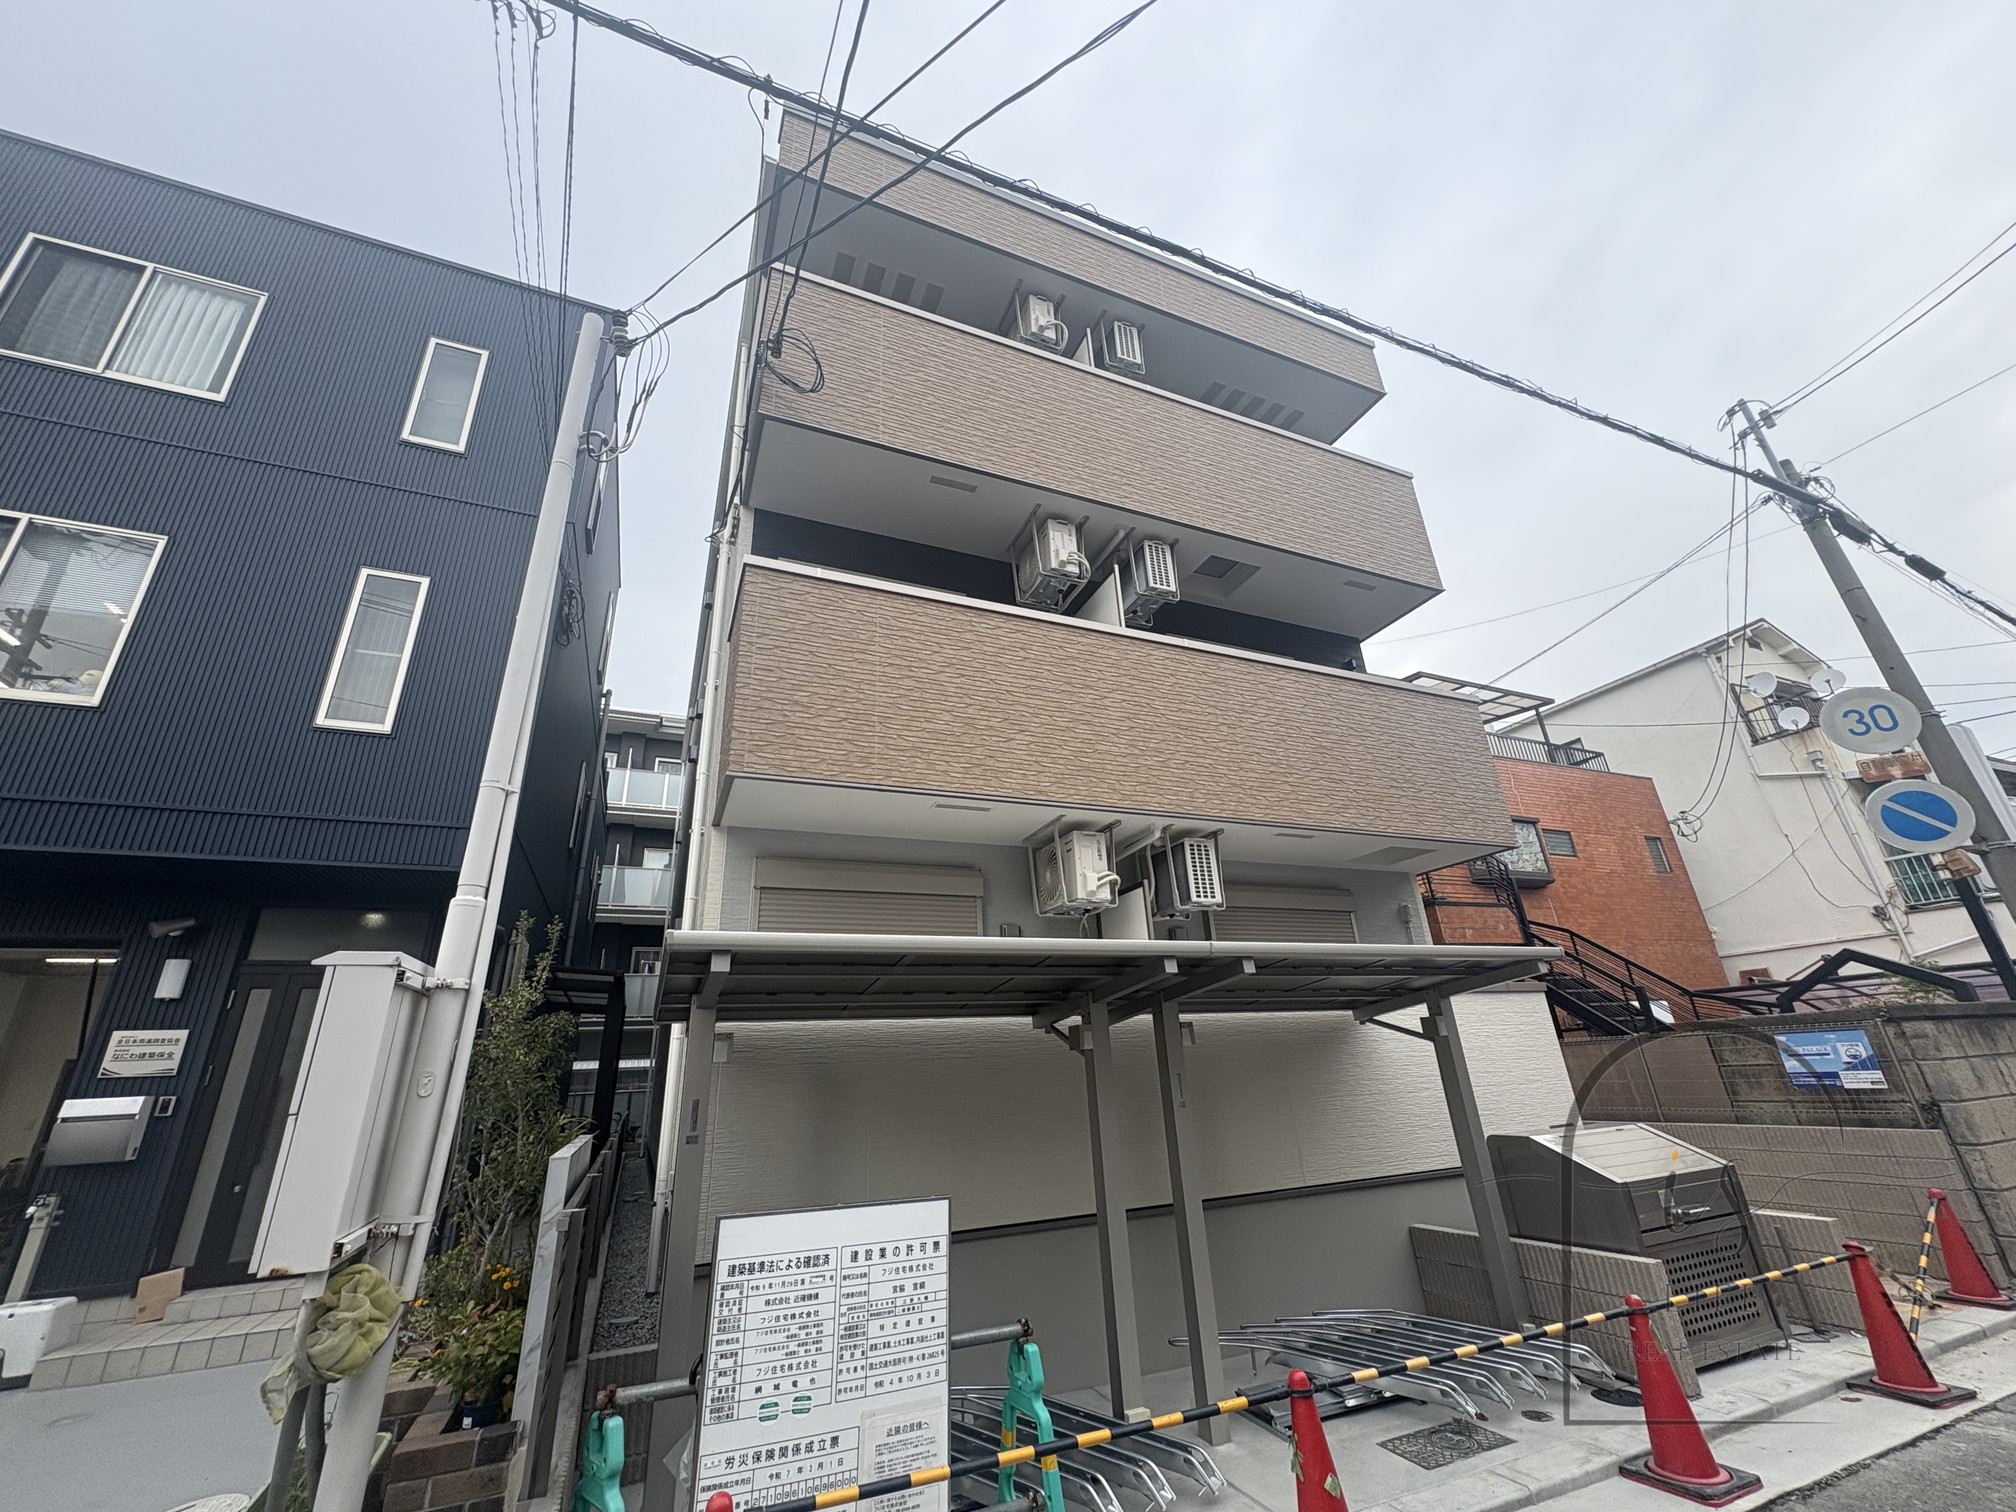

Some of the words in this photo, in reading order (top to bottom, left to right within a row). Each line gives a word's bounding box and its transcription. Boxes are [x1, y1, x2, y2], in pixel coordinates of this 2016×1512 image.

[1842, 704, 1899, 736] 30
[111, 1051, 176, 1060] なにわ建築保全
[850, 1240, 941, 1263] 建設業の許可票
[727, 1253, 831, 1278] 建築基準法による確認済
[881, 1262, 934, 1276] フジ住宅株式会社
[764, 1297, 791, 1307] 株式会社
[760, 1309, 820, 1325] フジ住宅株式会社
[755, 1359, 818, 1377] フジ住宅株式会社
[837, 1383, 865, 1396] 許可年月日
[886, 1420, 930, 1437] 近隣の皆様へ
[724, 1435, 840, 1470] 労災保険関係成立票
[768, 1457, 844, 1482] 令和7年3月1日
[699, 1476, 751, 1495] 保険関係成立年月日
